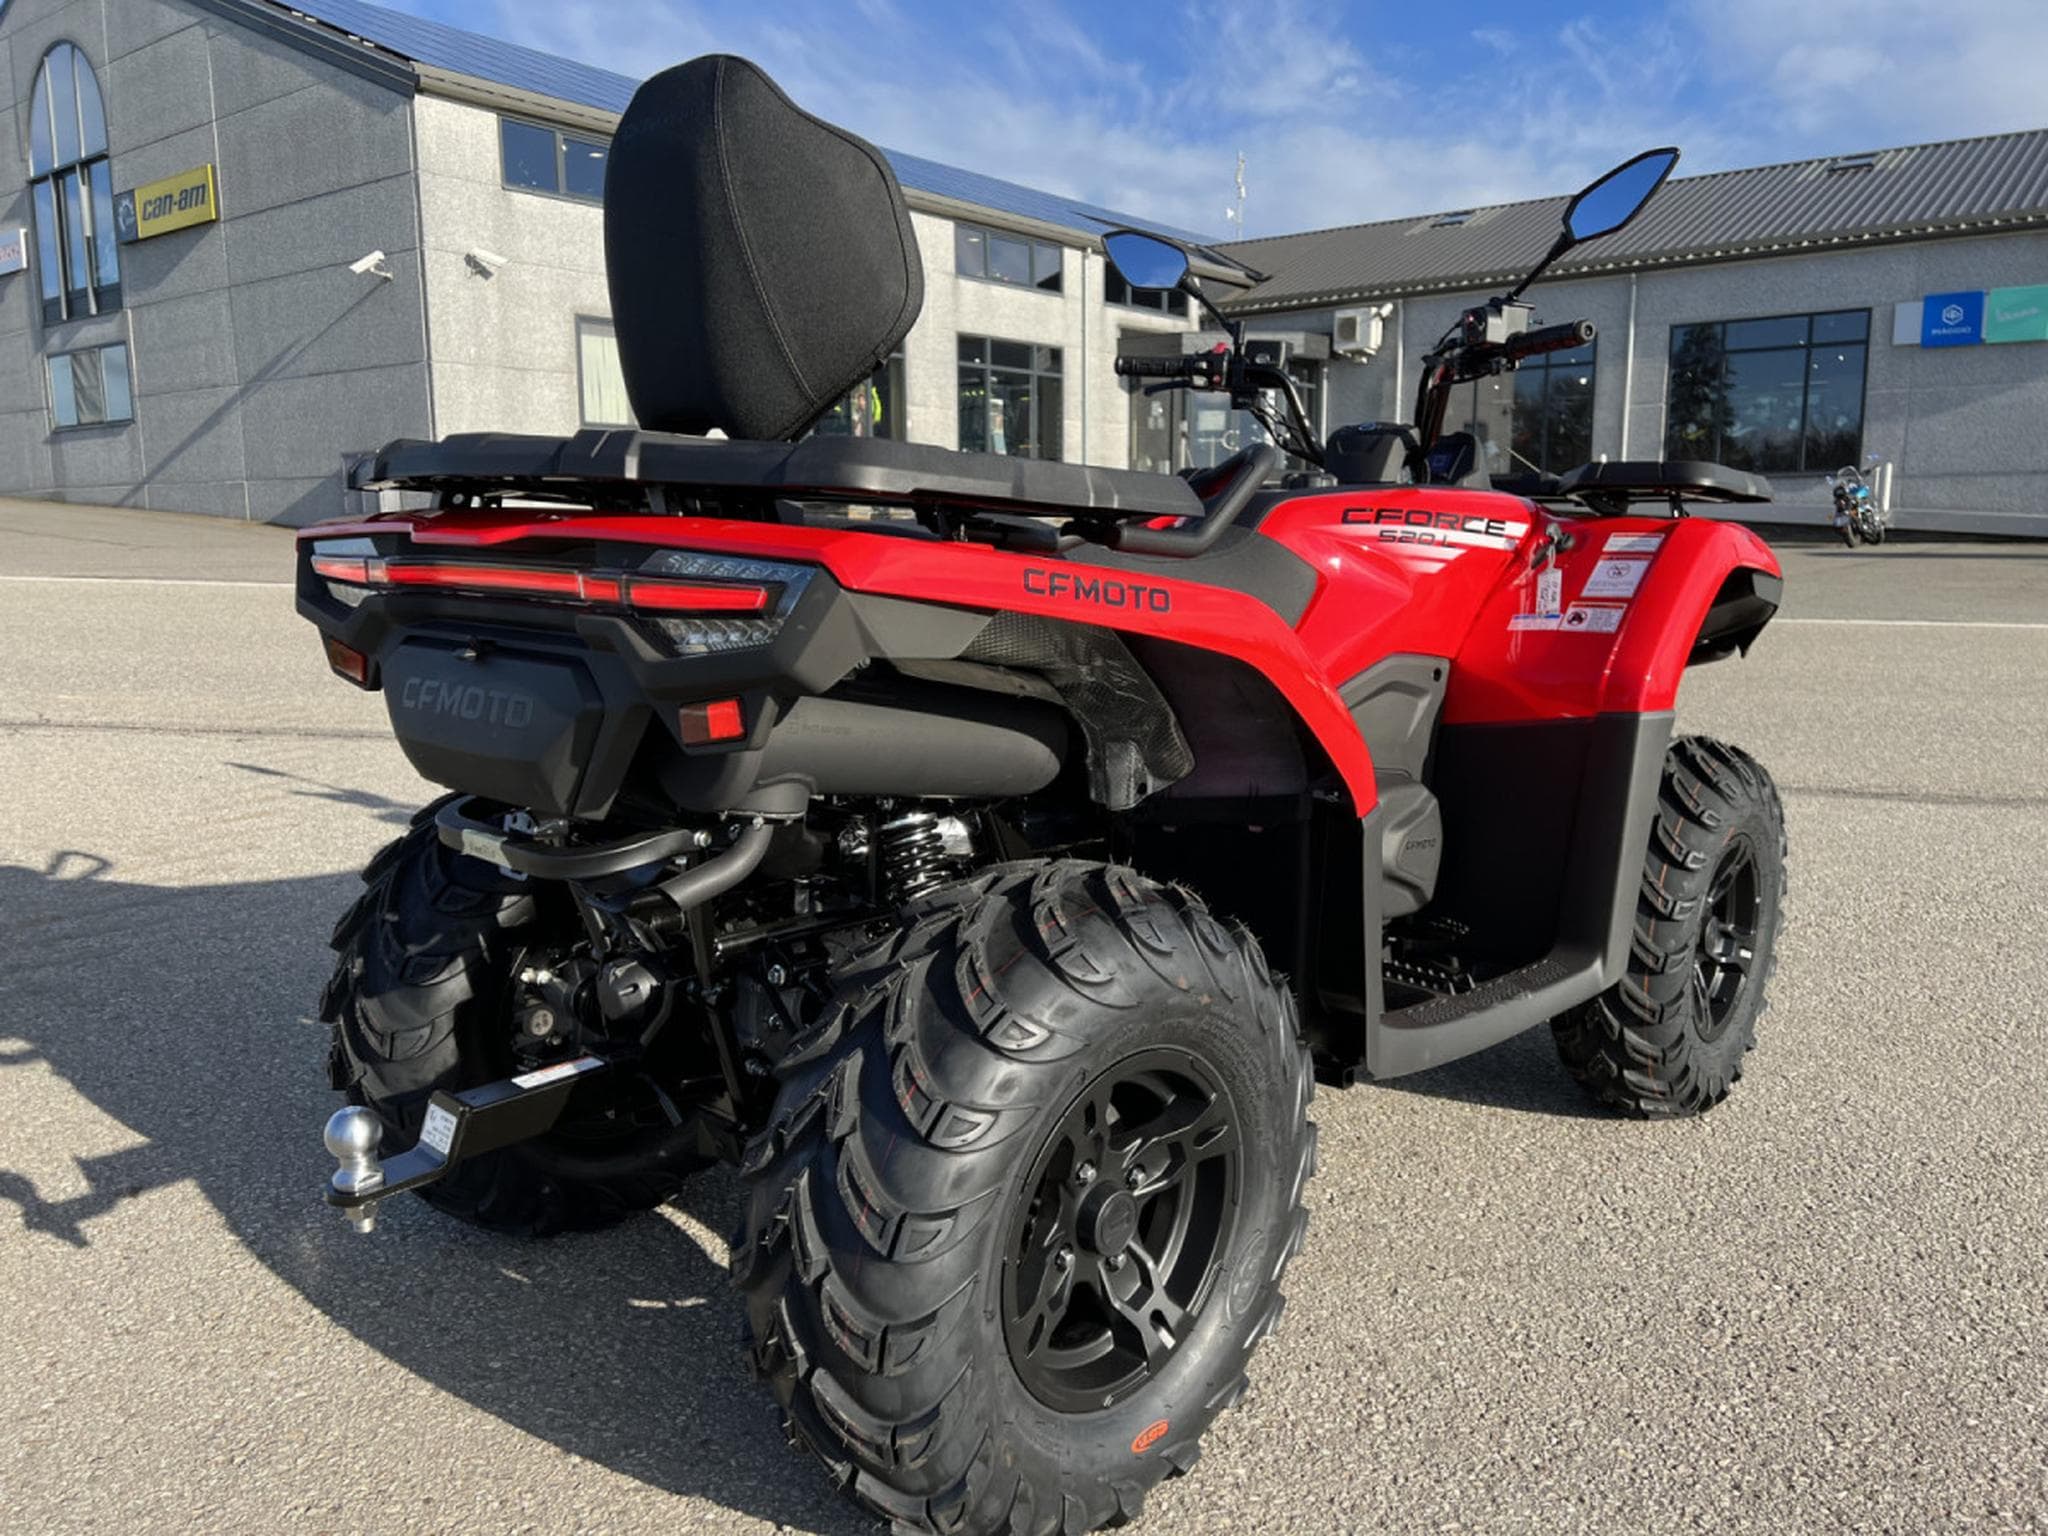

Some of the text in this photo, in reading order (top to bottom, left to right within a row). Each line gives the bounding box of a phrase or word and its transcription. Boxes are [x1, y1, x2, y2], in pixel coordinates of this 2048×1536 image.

[143, 184, 206, 221] can-am
[1341, 507, 1507, 538] CFORCE
[1378, 529, 1436, 546] 520
[1023, 567, 1171, 613] CFMOTO
[402, 677, 534, 728] CFMOTO
